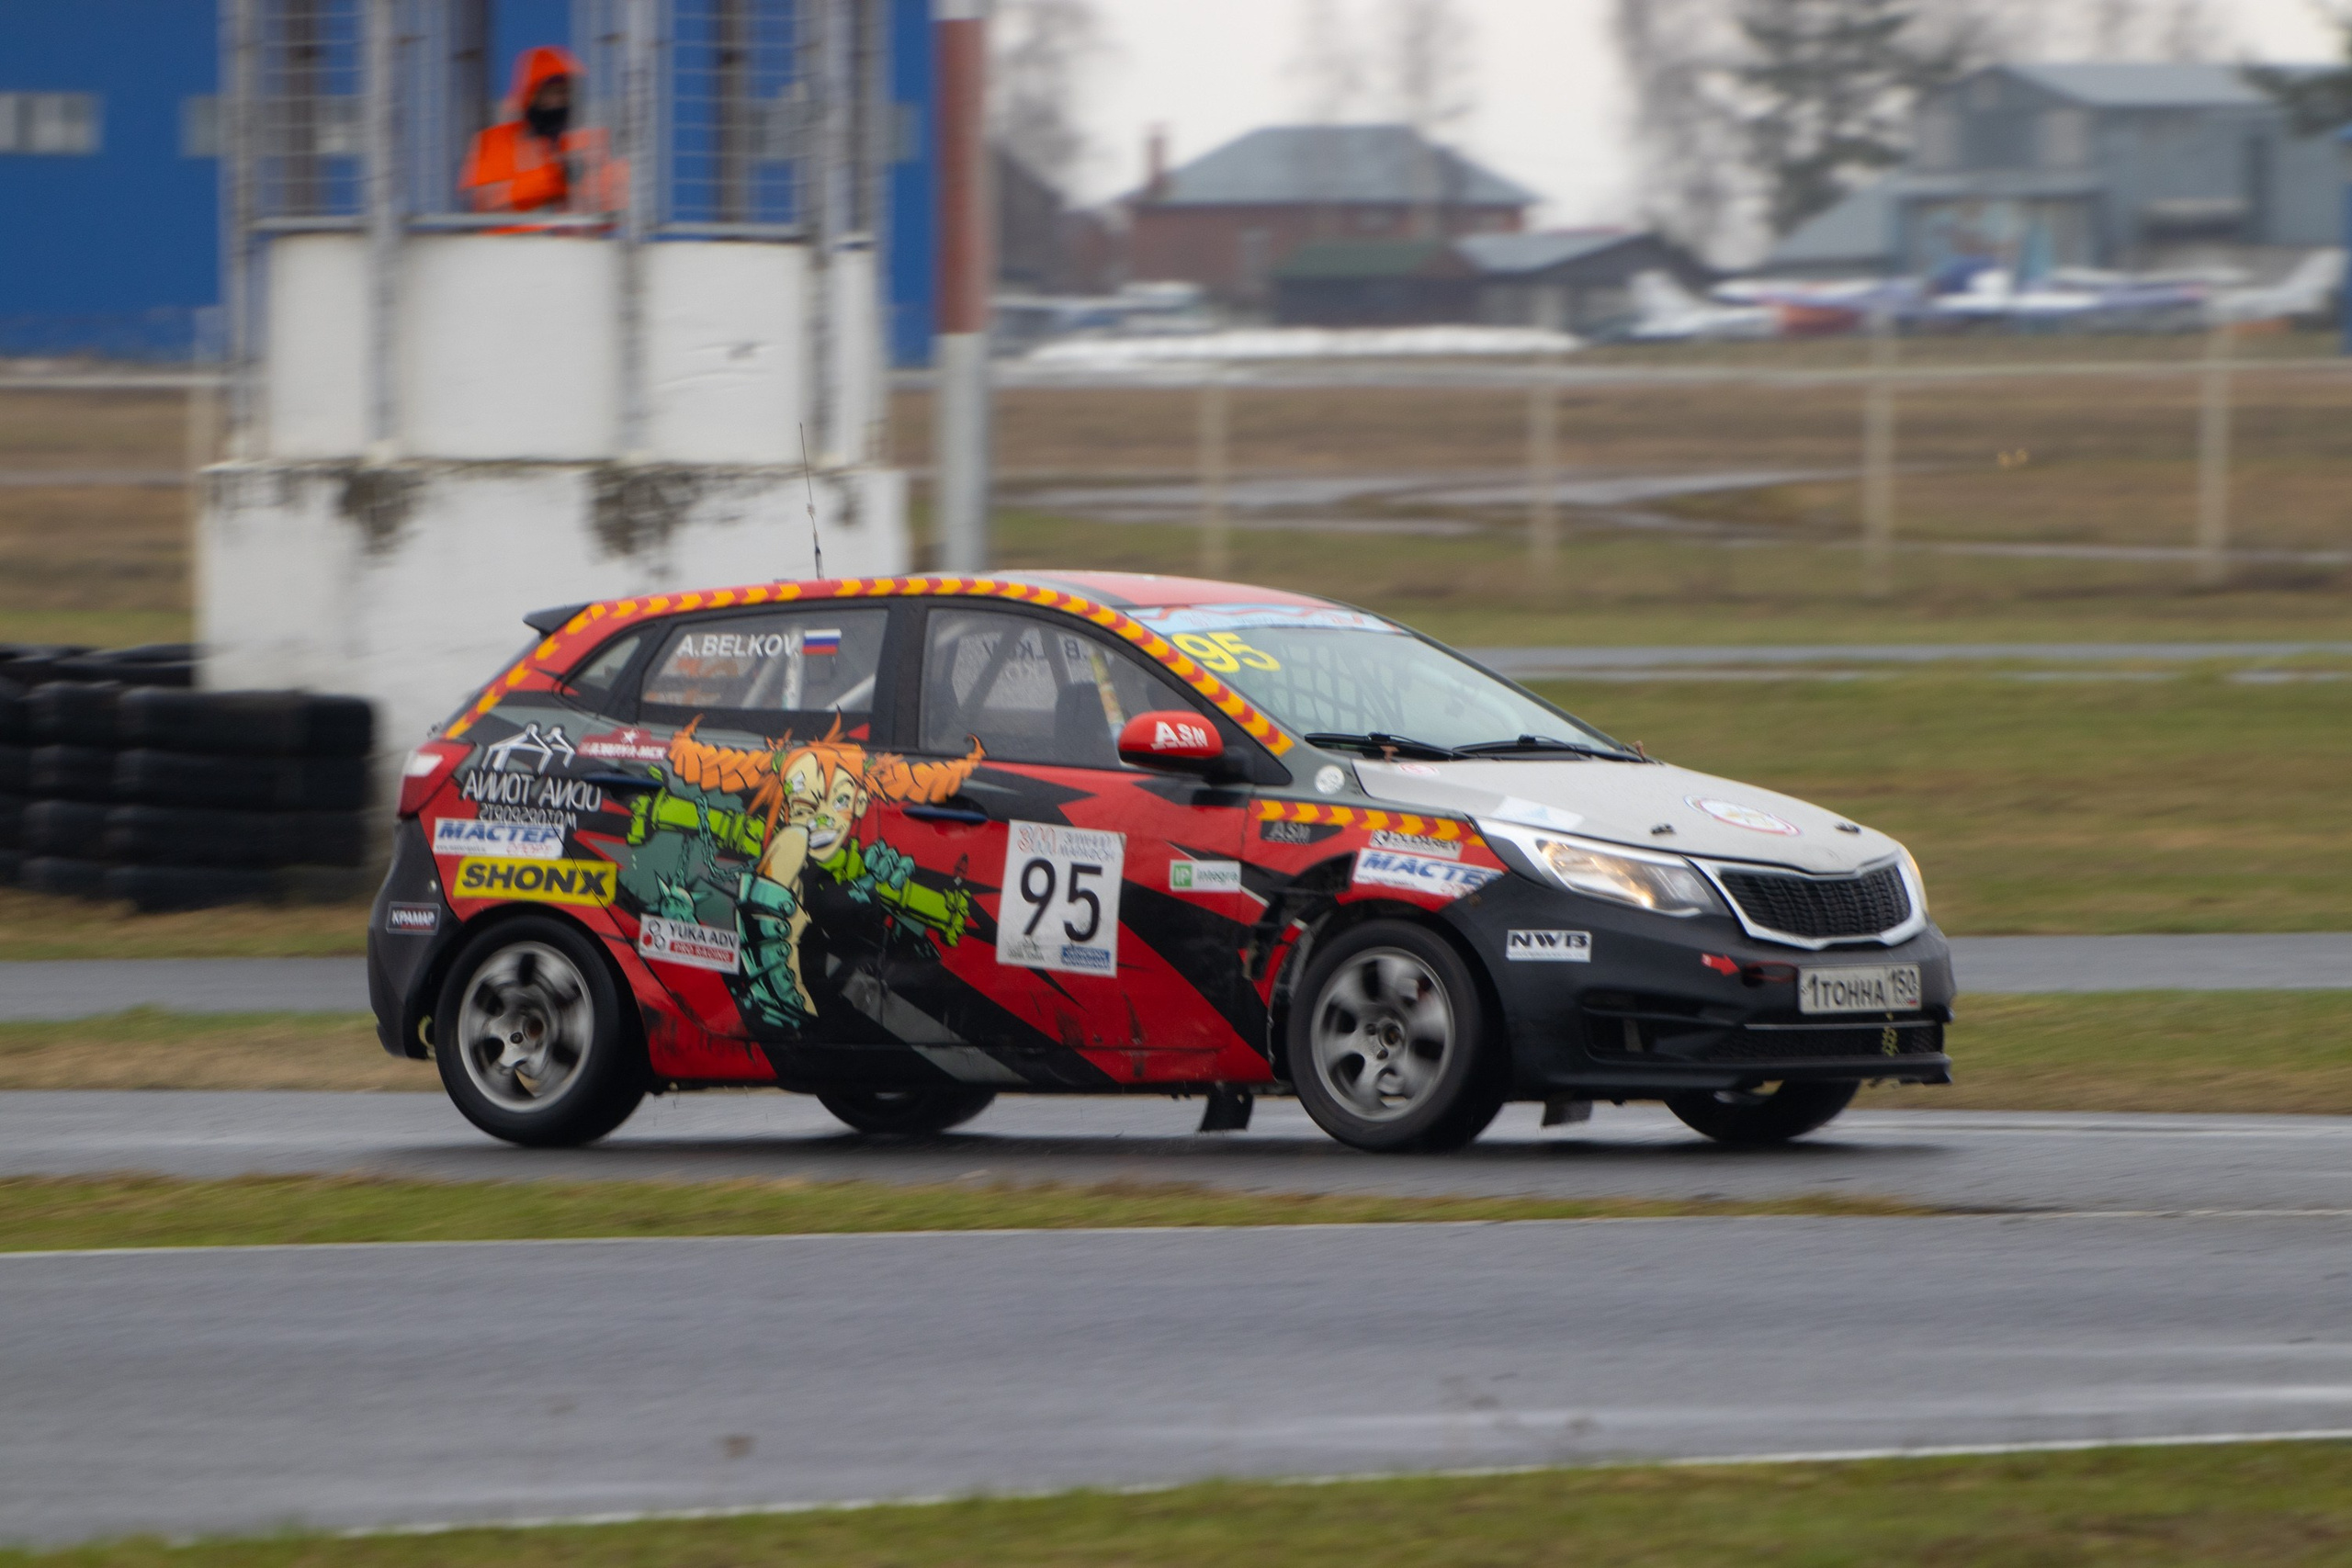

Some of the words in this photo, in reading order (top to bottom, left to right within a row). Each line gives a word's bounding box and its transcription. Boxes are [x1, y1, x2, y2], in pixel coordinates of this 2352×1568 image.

[676, 634, 801, 658] A.BELKOV
[1171, 632, 1281, 673] 95
[461, 863, 608, 897] SHONX
[1021, 856, 1102, 942] 95
[669, 922, 706, 943] YUKA
[709, 931, 738, 949] ADV
[1511, 931, 1588, 947] NWB
